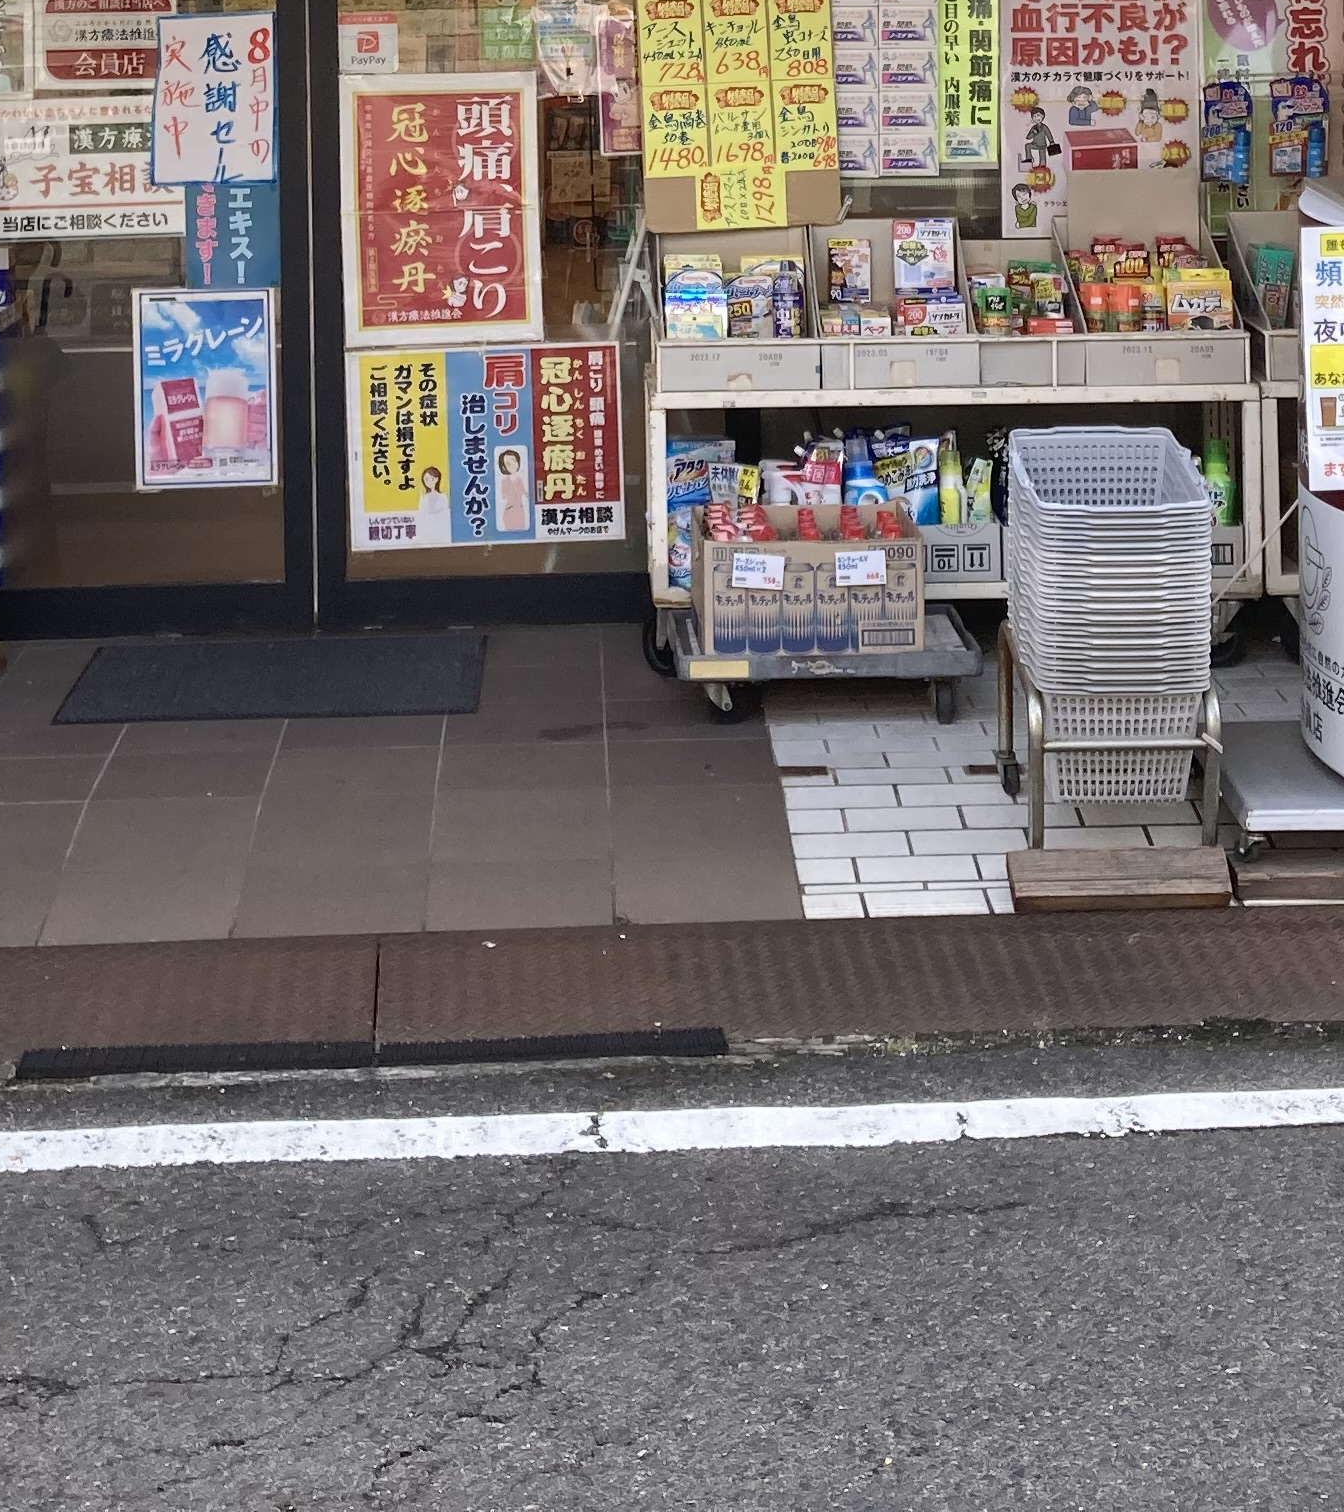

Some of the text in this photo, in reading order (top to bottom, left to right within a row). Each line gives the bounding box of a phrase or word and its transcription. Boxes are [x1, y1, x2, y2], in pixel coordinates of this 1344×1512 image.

[1011, 3, 1187, 35] 血行不良が
[74, 52, 146, 77] 会員店
[350, 56, 386, 67] PayPay
[786, 59, 829, 78] 808
[161, 36, 201, 159] 実施中
[198, 33, 244, 184] 感謝セール
[944, 77, 961, 127] 内服薬
[2, 212, 169, 233] 当店にご相談ください
[1171, 293, 1221, 314] ムカデ
[418, 362, 439, 427] その症状
[483, 354, 527, 436] 肩コリ
[394, 363, 416, 491] ガマンは損ですよ
[541, 507, 614, 526] 漢方相談
